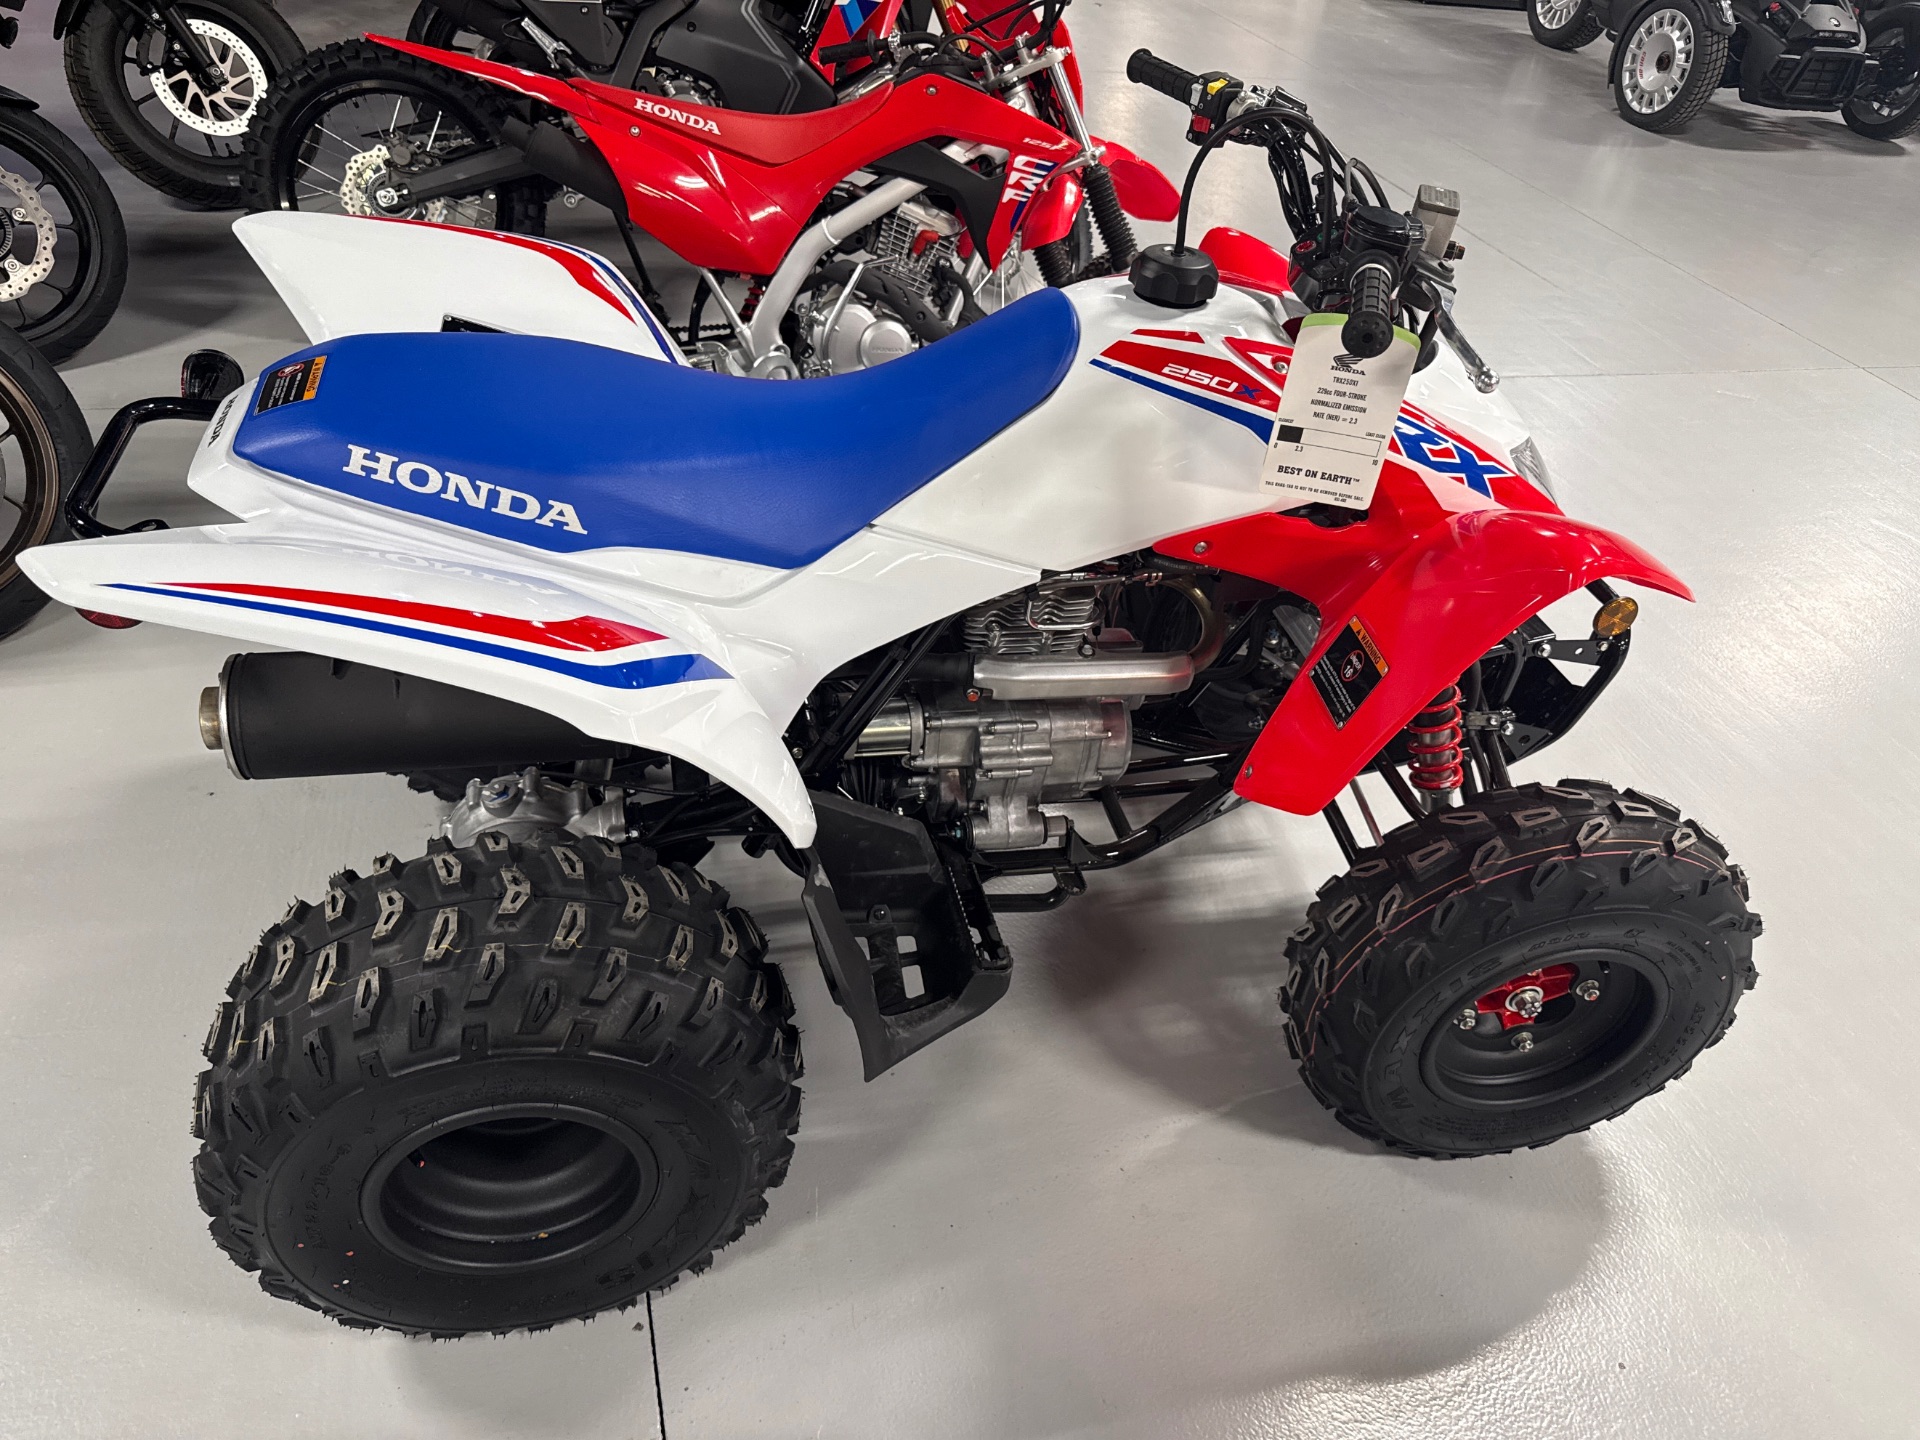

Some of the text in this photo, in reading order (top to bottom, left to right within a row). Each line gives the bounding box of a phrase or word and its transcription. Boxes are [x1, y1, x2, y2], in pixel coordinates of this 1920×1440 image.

[634, 97, 721, 136] HONDA
[1002, 154, 1055, 203] CRF
[1161, 363, 1263, 400] 250X
[1330, 365, 1366, 376] HONDA
[1310, 399, 1367, 414] NORMALIZED EMISSION
[1317, 387, 1367, 401] 229cc FOUR-STROKE
[208, 395, 238, 448] HONDA
[1313, 411, 1325, 420] RATE
[1325, 413, 1341, 422] (NER)
[1348, 416, 1358, 425] 2.3
[1294, 445, 1304, 453] 2.3
[1393, 412, 1510, 500] RX
[1277, 465, 1303, 476] BEST
[1304, 469, 1319, 478] ON
[342, 443, 589, 535] HONDA
[1360, 633, 1381, 665] WARNING
[1344, 665, 1353, 678] 16
[1384, 956, 1503, 1110] MAXXIS
